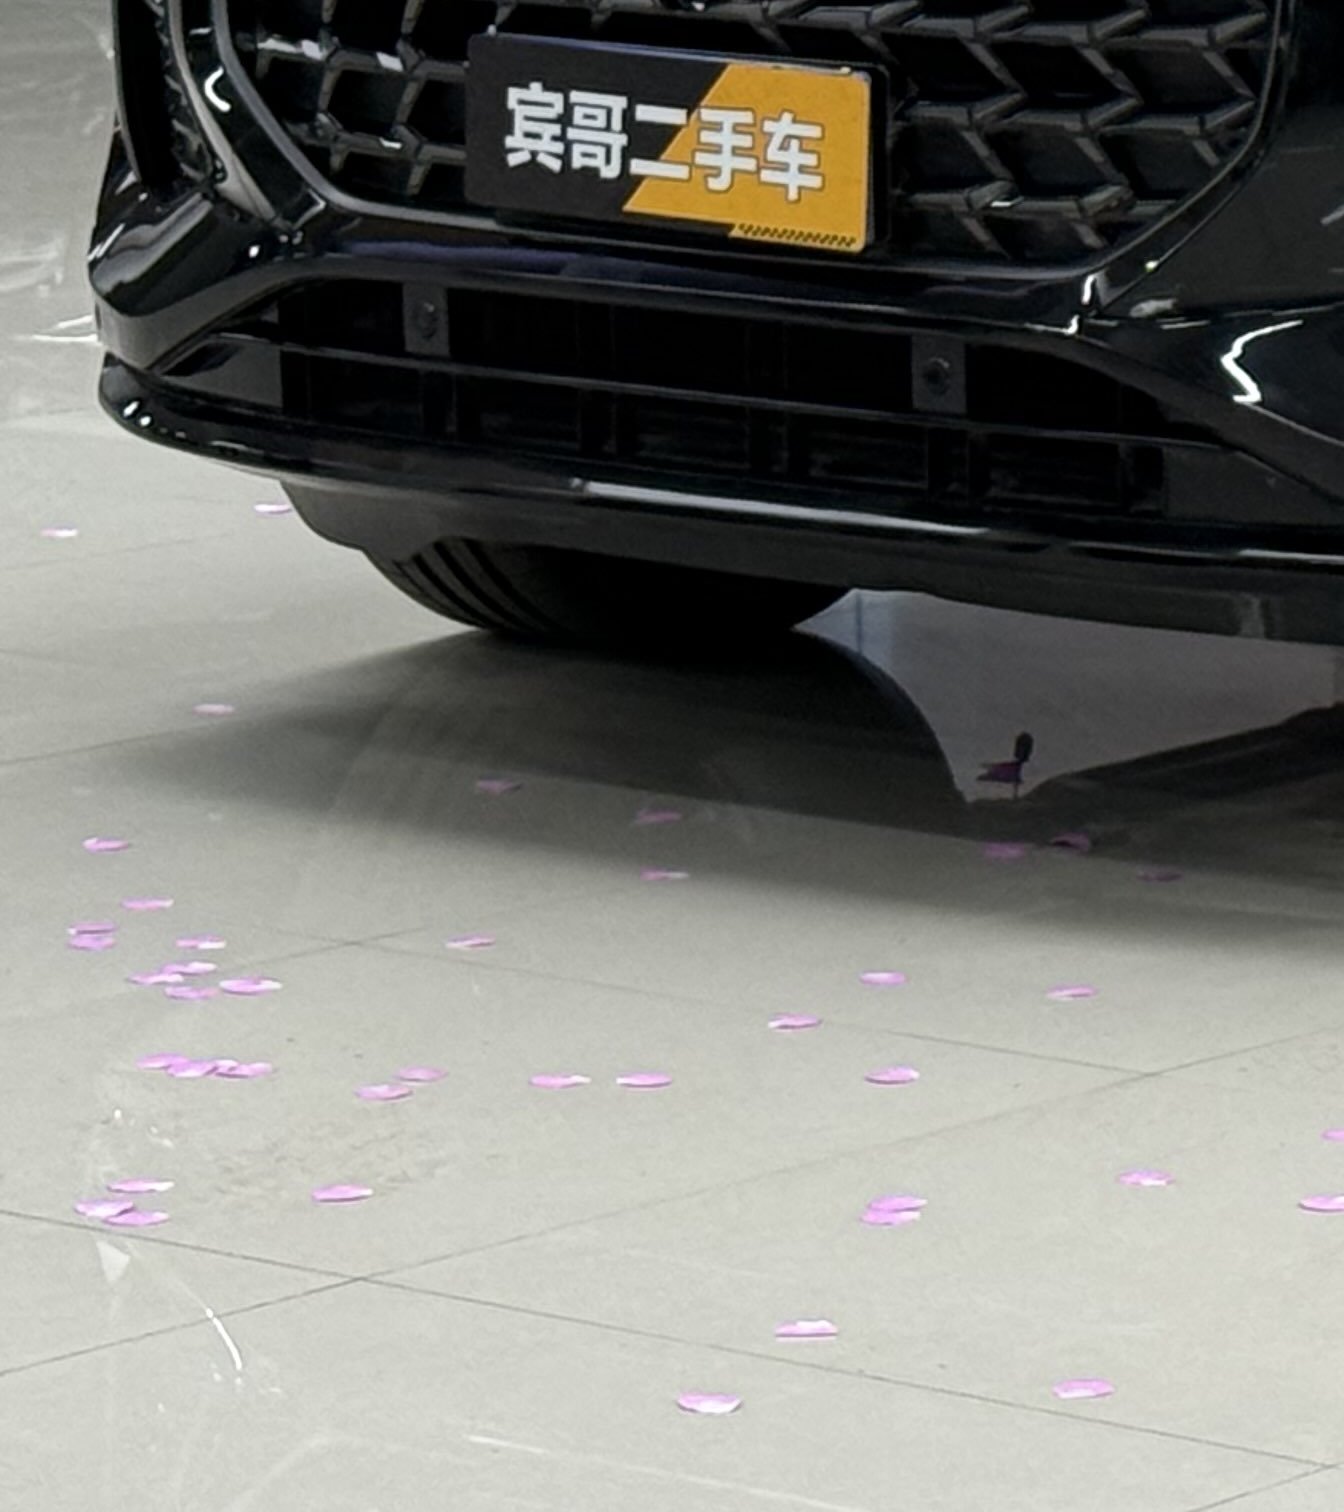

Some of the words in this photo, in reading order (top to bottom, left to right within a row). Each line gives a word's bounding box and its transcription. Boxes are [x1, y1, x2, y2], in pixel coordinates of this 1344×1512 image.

[505, 82, 823, 202] 宾哥二手车
